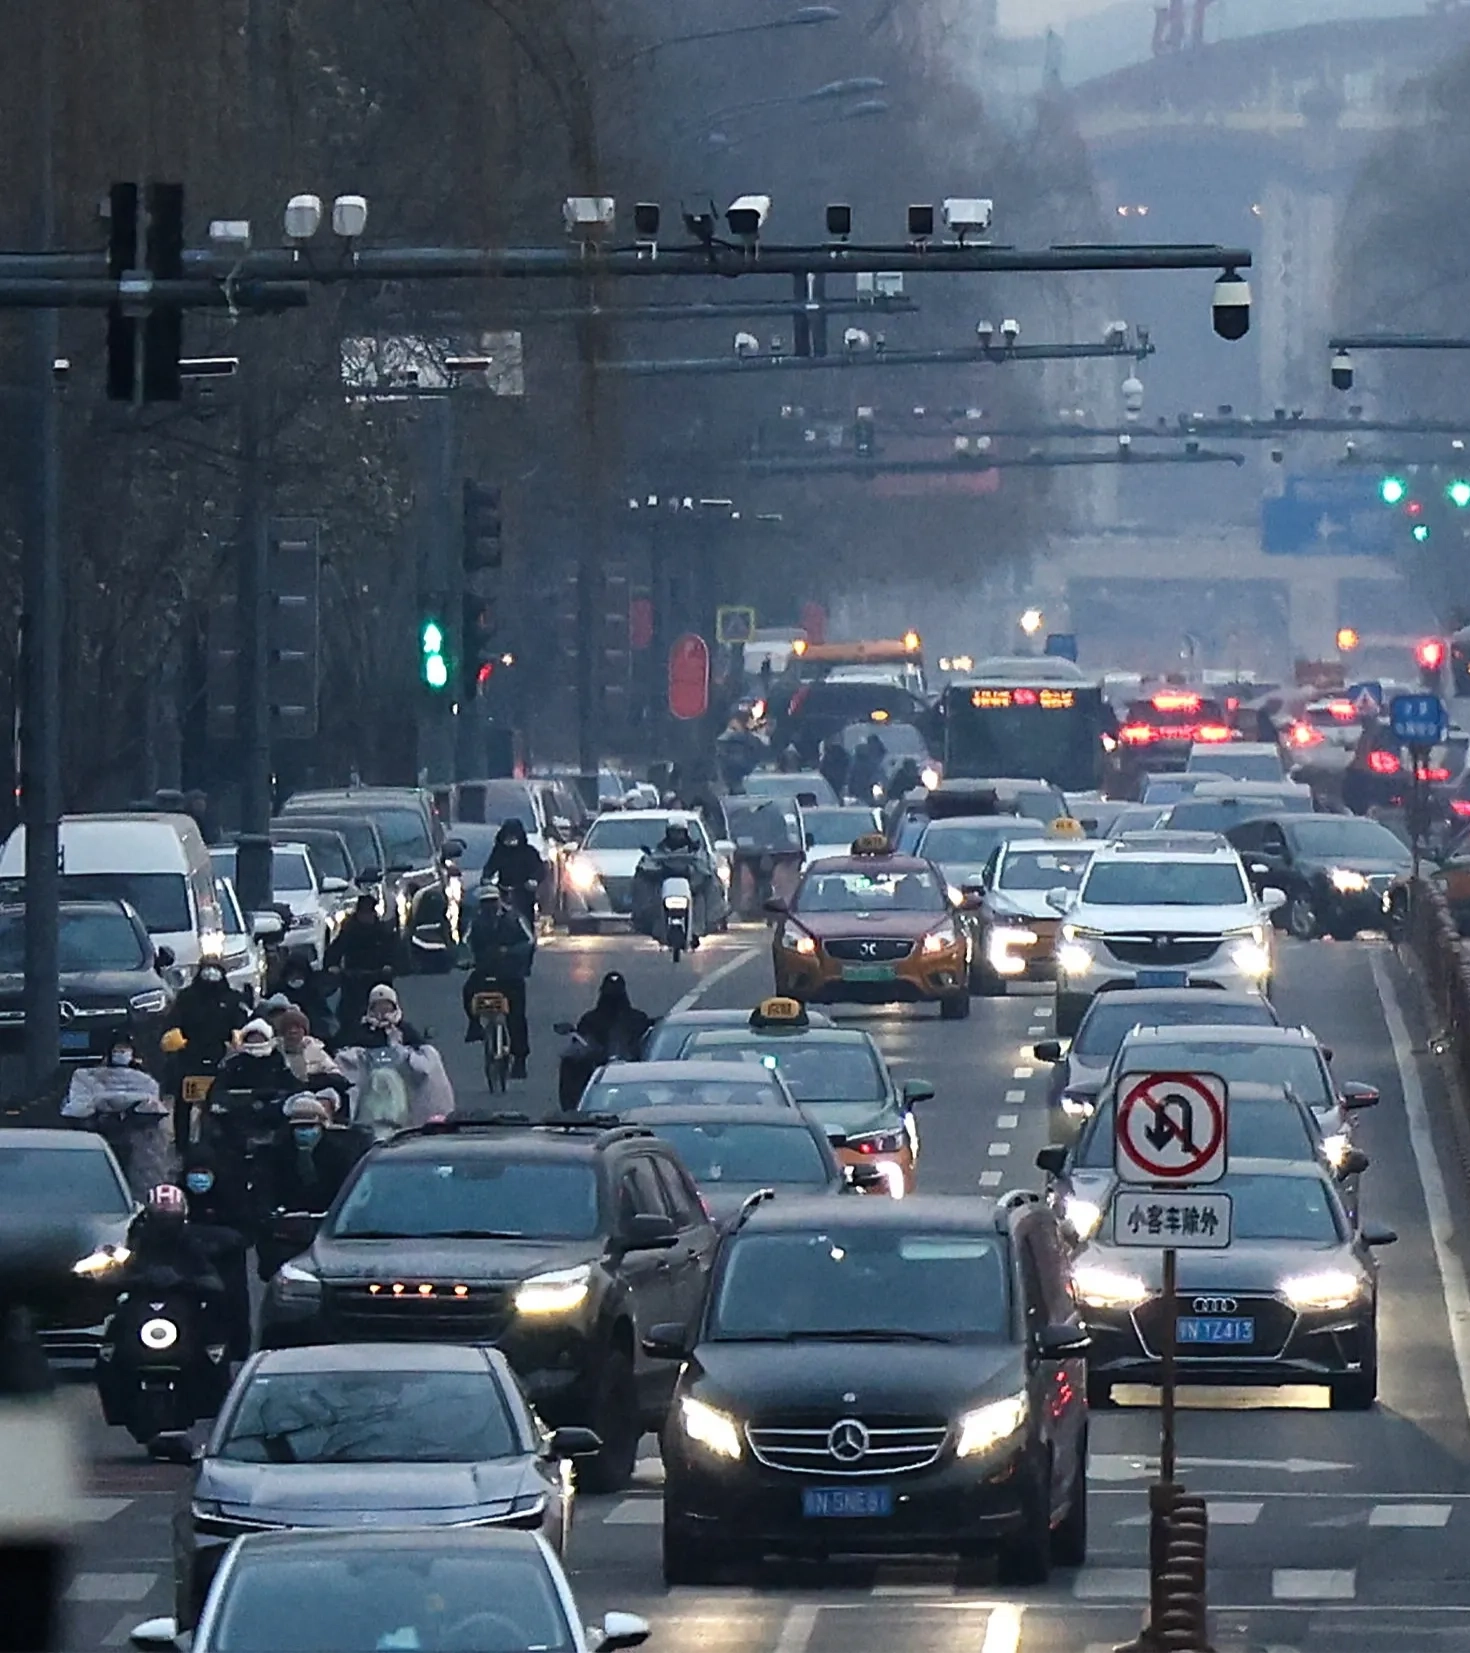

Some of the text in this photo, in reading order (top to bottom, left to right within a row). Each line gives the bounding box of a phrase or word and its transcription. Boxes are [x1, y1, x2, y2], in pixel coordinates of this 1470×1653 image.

[1127, 1204, 1219, 1237] 小客车除外
